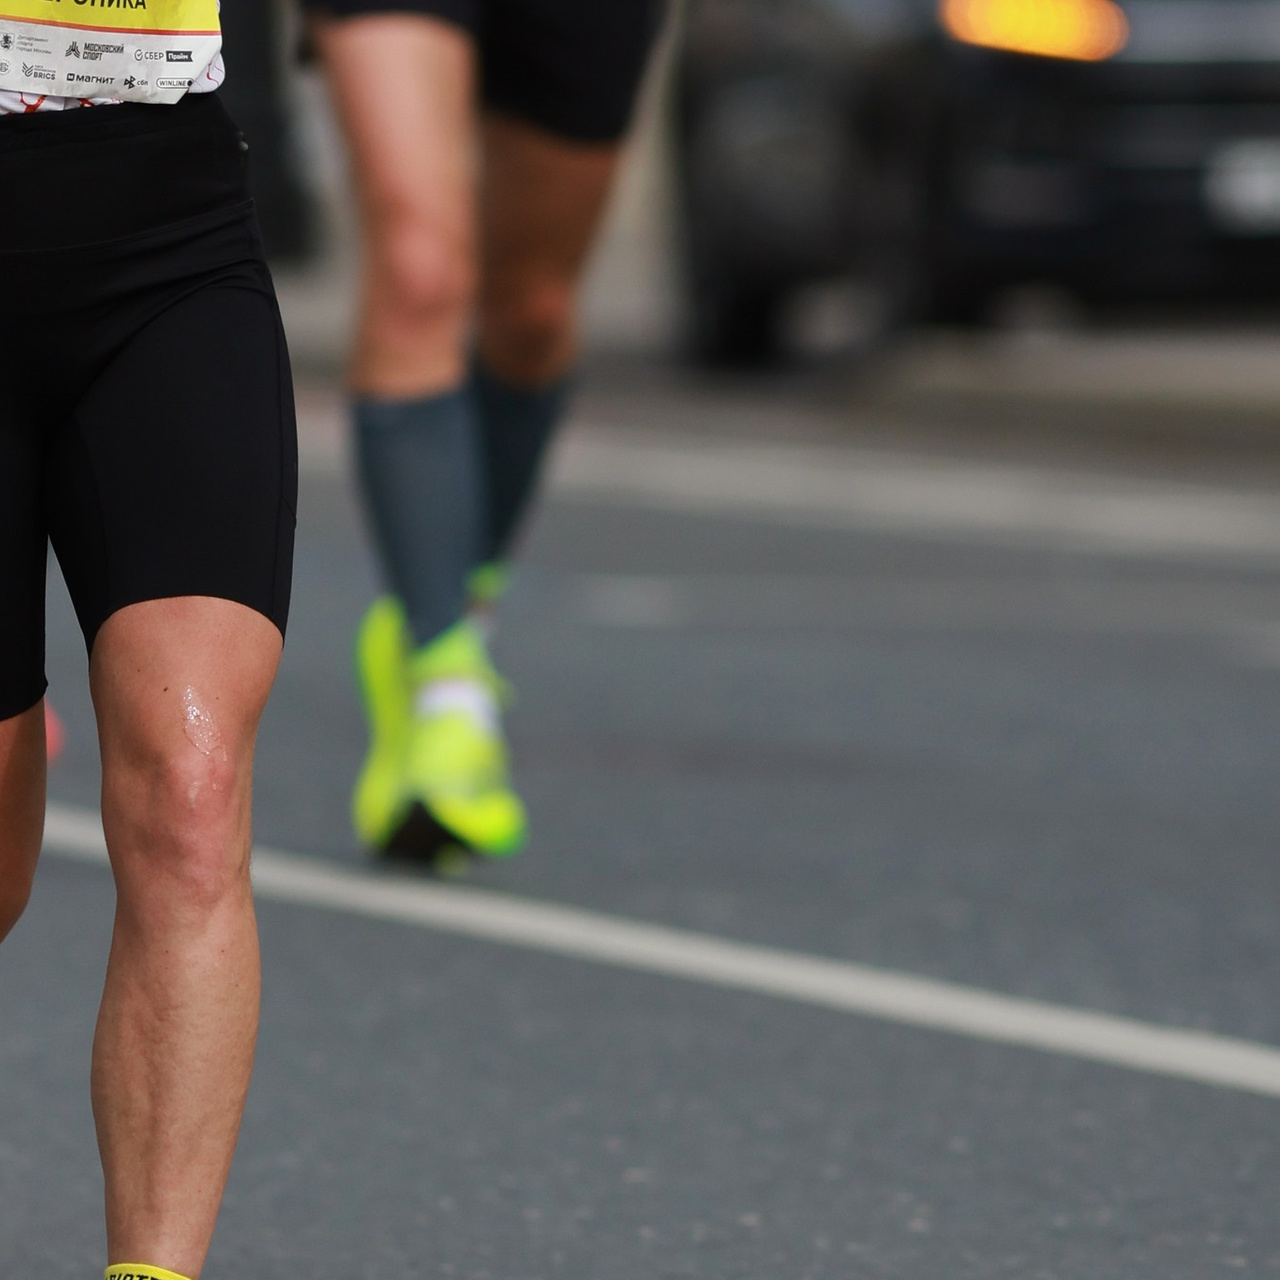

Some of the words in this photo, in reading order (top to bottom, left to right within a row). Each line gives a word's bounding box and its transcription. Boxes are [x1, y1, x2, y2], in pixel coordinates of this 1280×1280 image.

[83, 42, 125, 54] МОСКОВСКИЙ
[82, 51, 103, 61] СПОРТ
[144, 51, 165, 60] СБЕР
[168, 52, 189, 60] Прайм
[33, 71, 56, 81] BRICS
